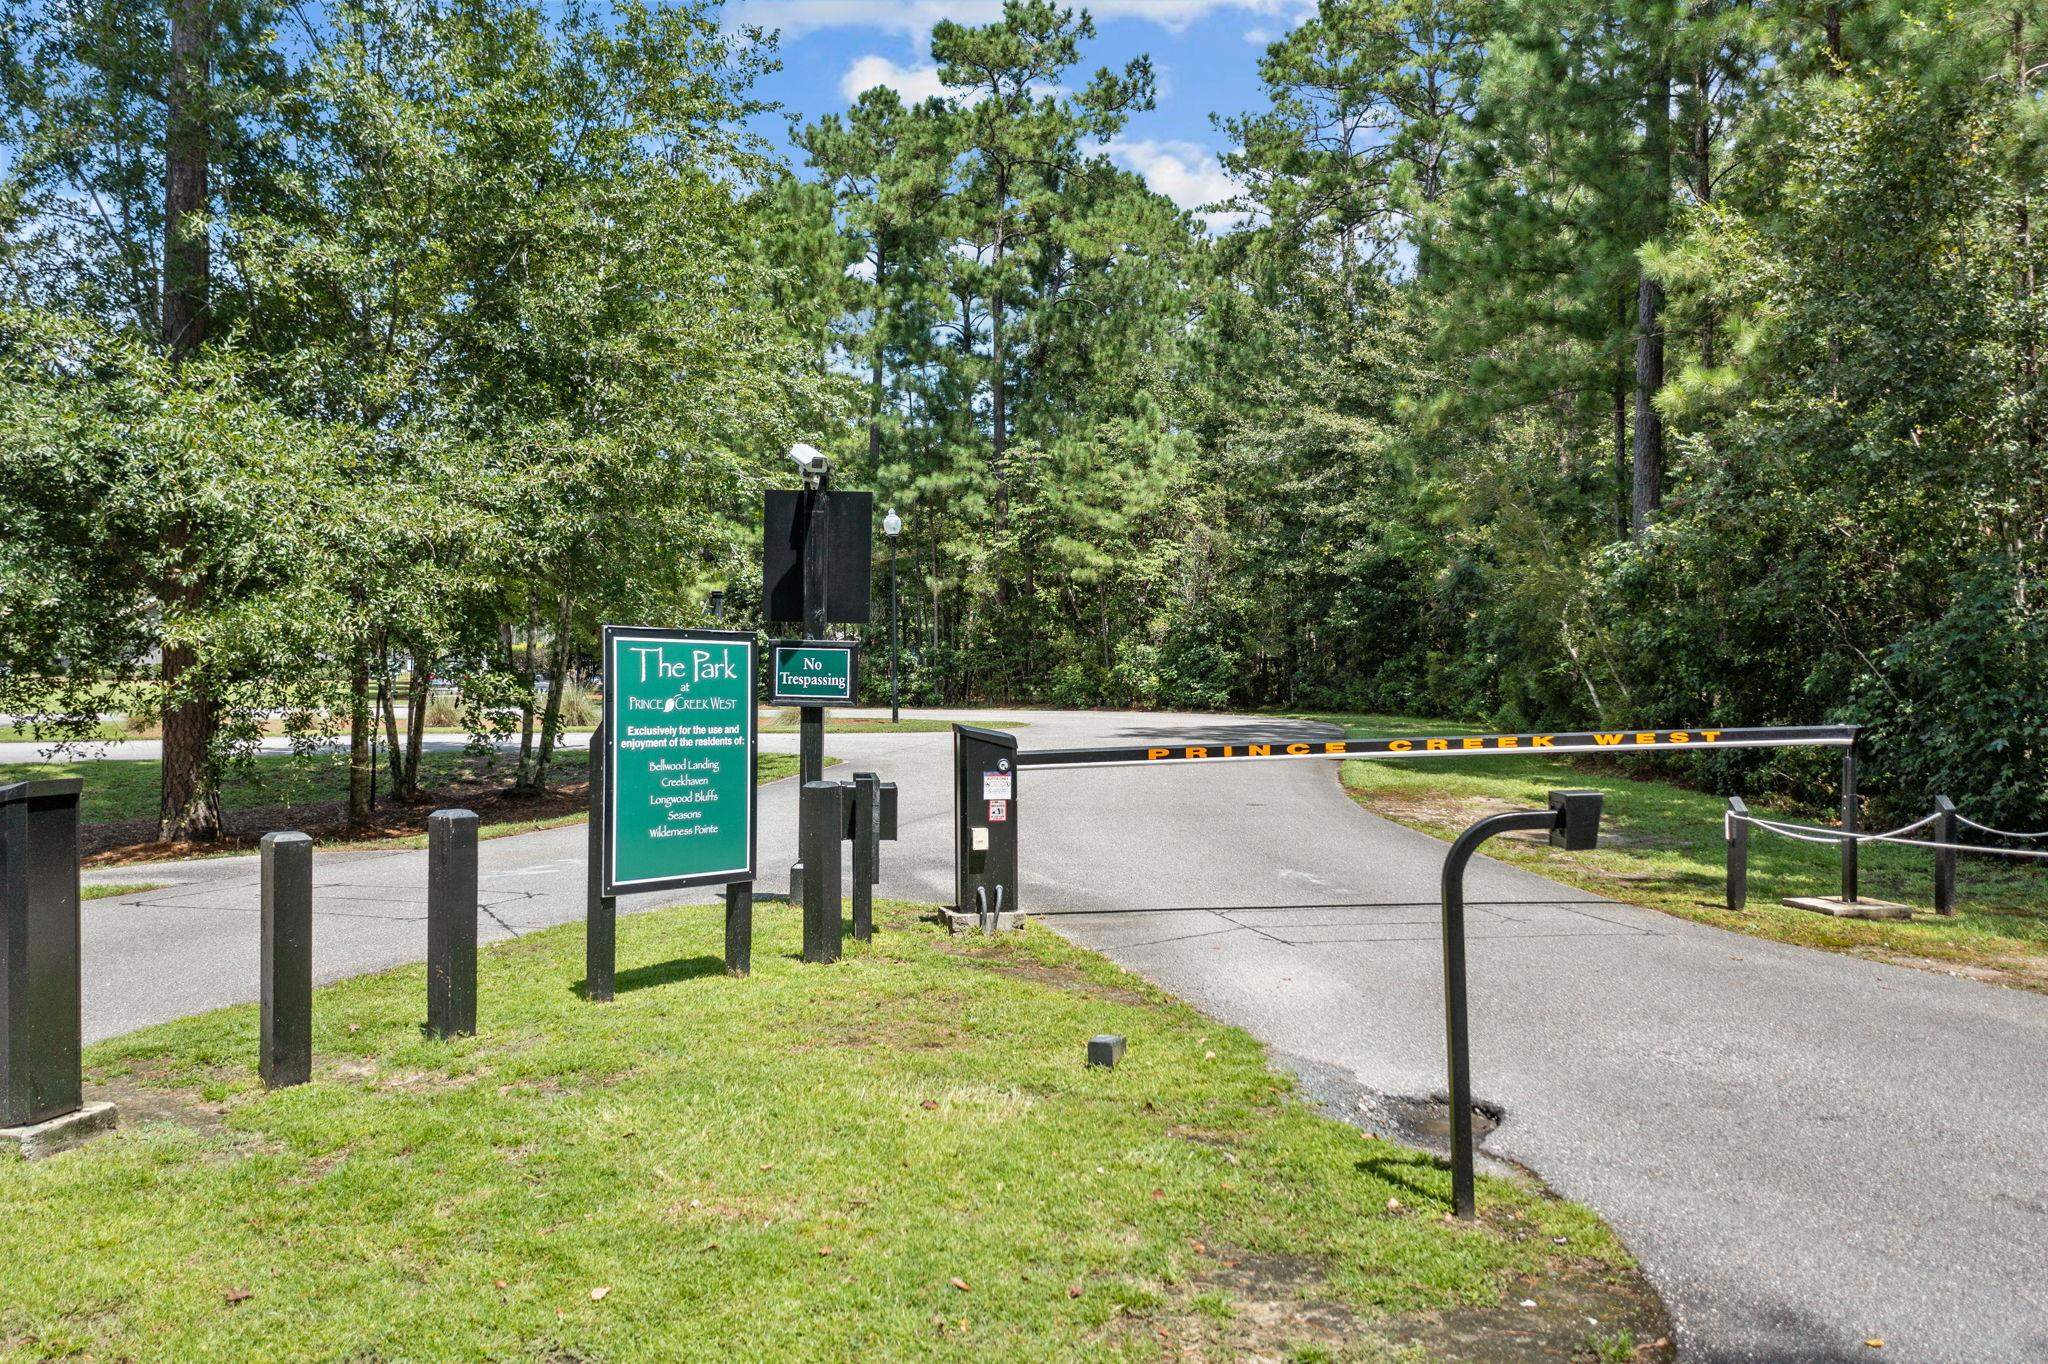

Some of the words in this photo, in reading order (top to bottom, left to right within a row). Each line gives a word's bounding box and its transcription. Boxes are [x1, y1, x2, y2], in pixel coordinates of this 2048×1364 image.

[629, 647, 686, 682] The
[693, 648, 737, 682] Park
[803, 657, 822, 670] No
[680, 682, 690, 692] at
[780, 671, 846, 689] Trespassing
[629, 696, 664, 710] PRINCE
[675, 696, 709, 710] CREEK
[710, 697, 737, 710] WEST
[627, 725, 677, 737] Exclusively
[679, 725, 691, 735] for
[693, 725, 706, 735] the
[708, 726, 723, 734] use
[724, 724, 739, 734] and
[621, 739, 667, 750] enjoyment
[669, 738, 678, 747] of
[680, 738, 693, 747] the
[695, 736, 732, 747] residents
[734, 736, 745, 745] of:
[1148, 742, 1346, 760] PRINCE
[1388, 735, 1556, 752] CREEK
[1593, 731, 1721, 746] WEST
[649, 758, 687, 771] Bellwood
[688, 757, 720, 772] Landing
[661, 774, 709, 787] Creekhaven
[650, 790, 693, 807] Longwood
[695, 789, 719, 802] Bluffs
[667, 810, 702, 821] Seasons
[649, 825, 693, 838] Wilderness
[694, 824, 719, 835] Pointe
